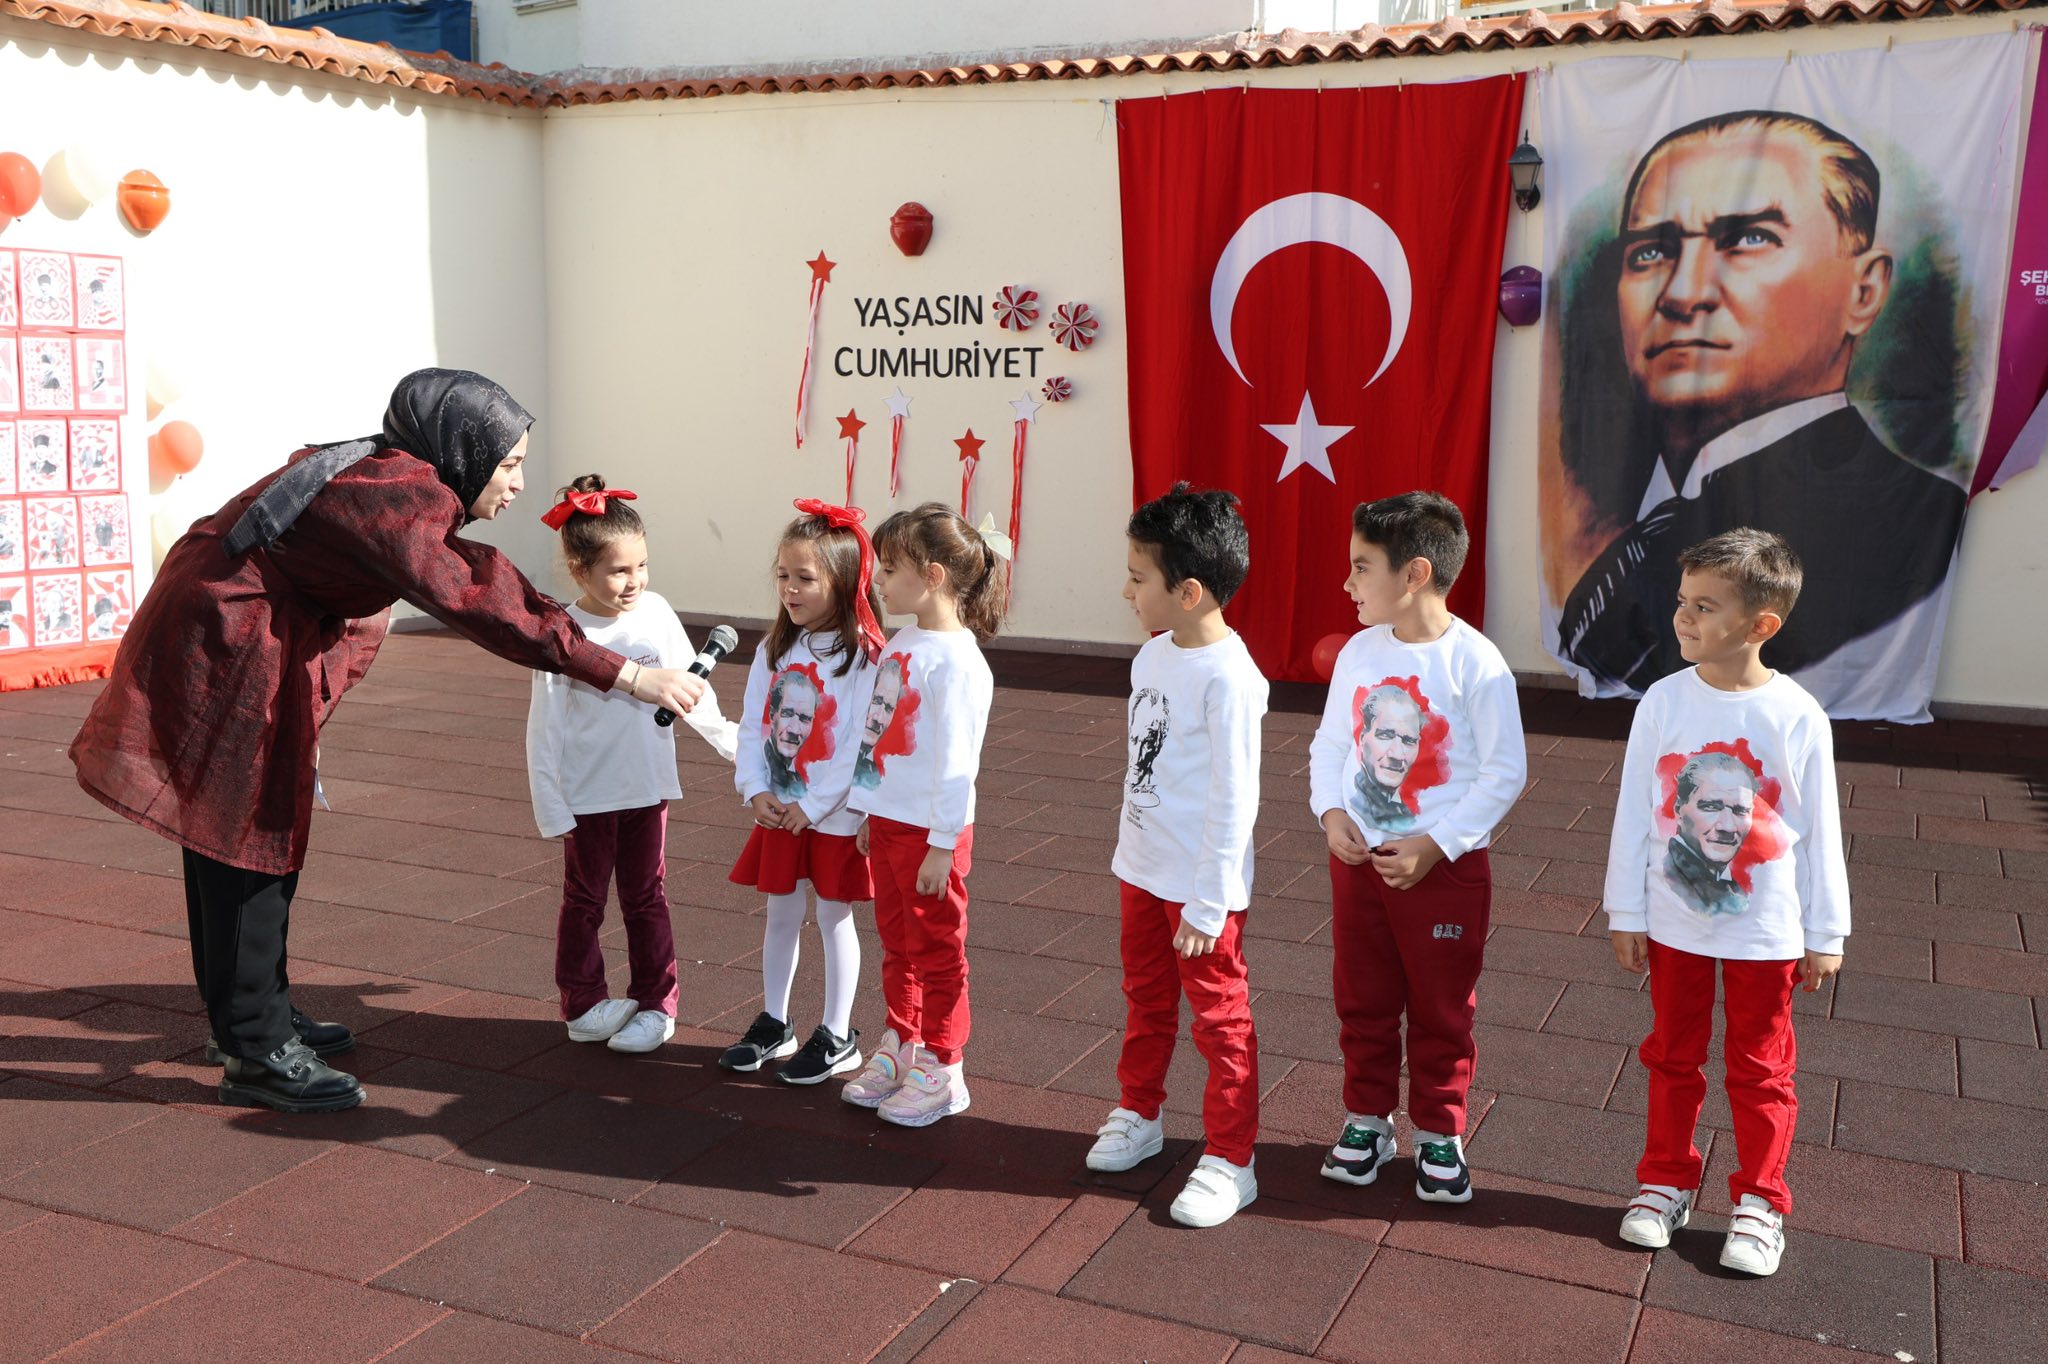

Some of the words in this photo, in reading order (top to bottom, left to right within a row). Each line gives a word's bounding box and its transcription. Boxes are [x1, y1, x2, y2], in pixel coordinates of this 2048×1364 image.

[2035, 285, 2048, 296] B
[854, 294, 983, 336] YAŞASIN
[834, 340, 1044, 378] CUMHURİYET
[1432, 923, 1463, 940] GAP
